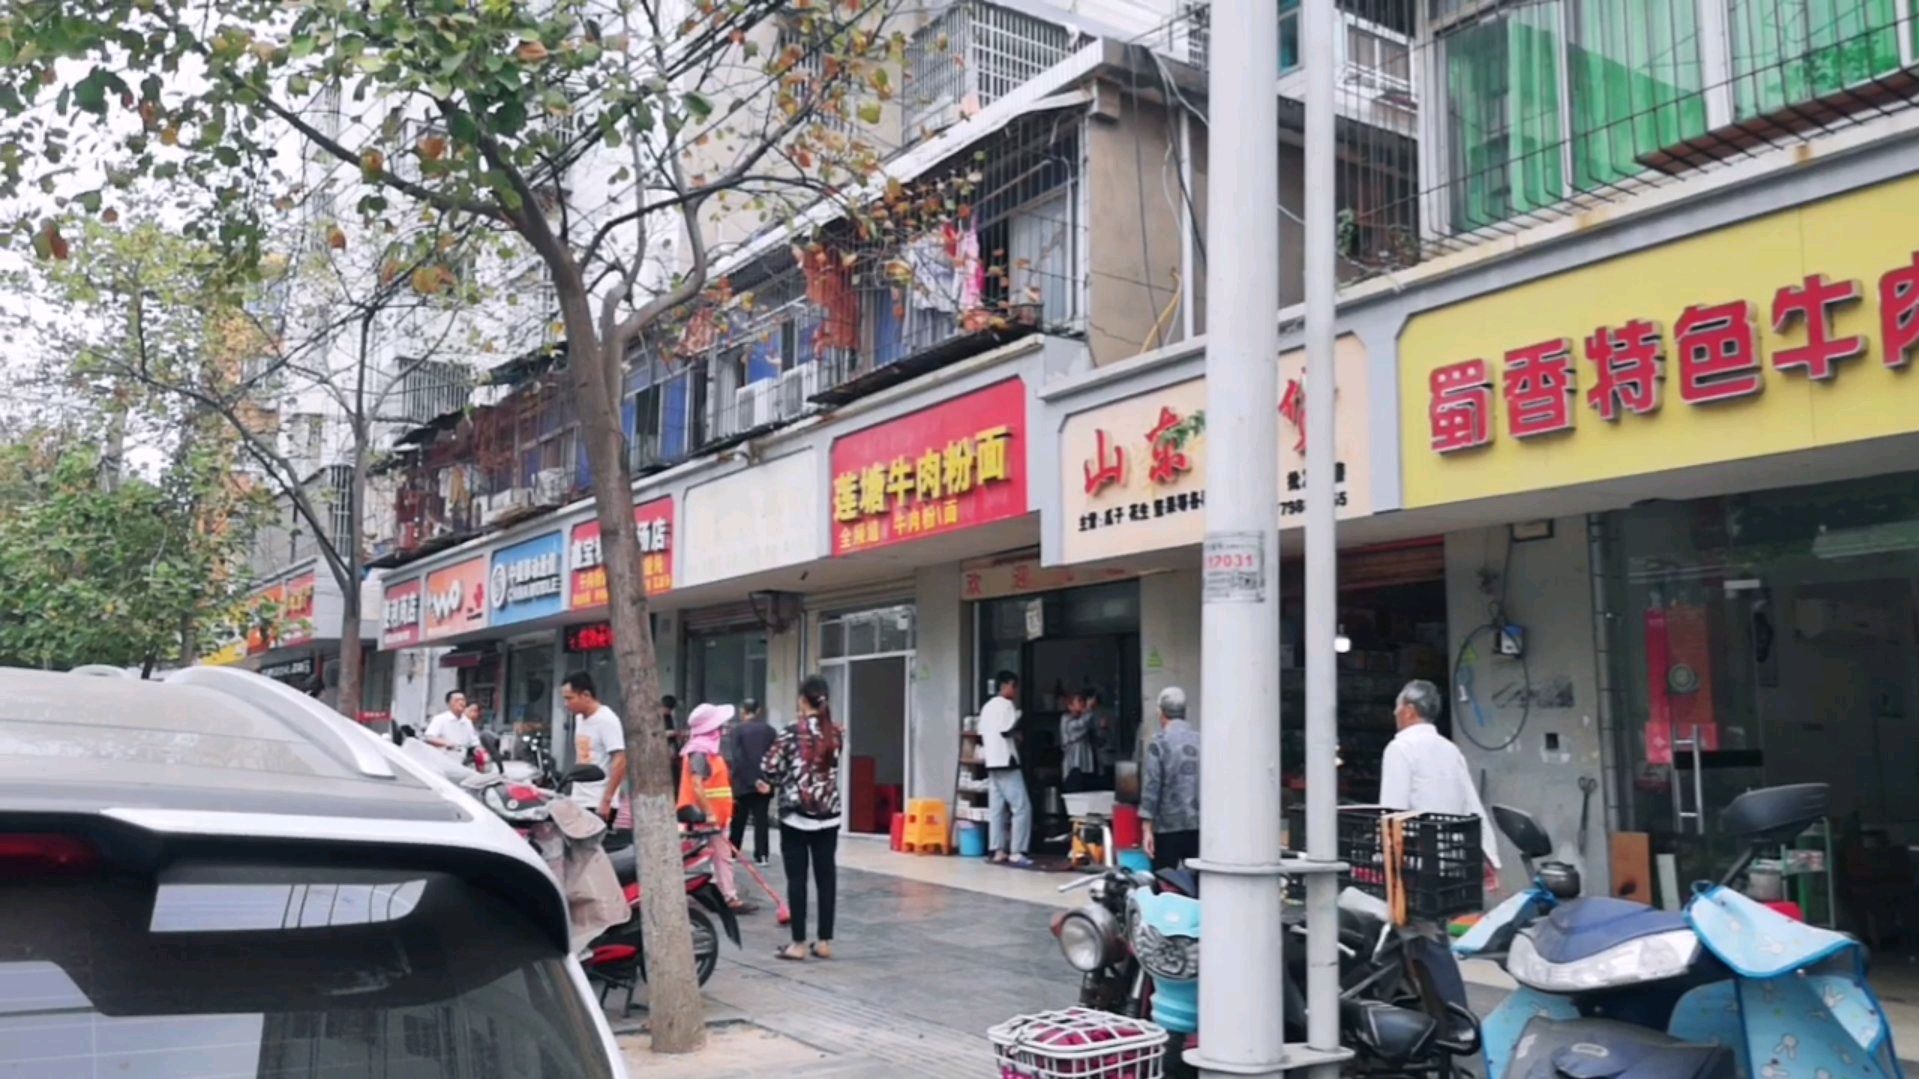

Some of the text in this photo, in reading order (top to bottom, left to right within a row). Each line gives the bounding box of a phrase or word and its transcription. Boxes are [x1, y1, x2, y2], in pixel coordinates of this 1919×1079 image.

[834, 424, 1010, 521] 莲塘牛肉粉面
